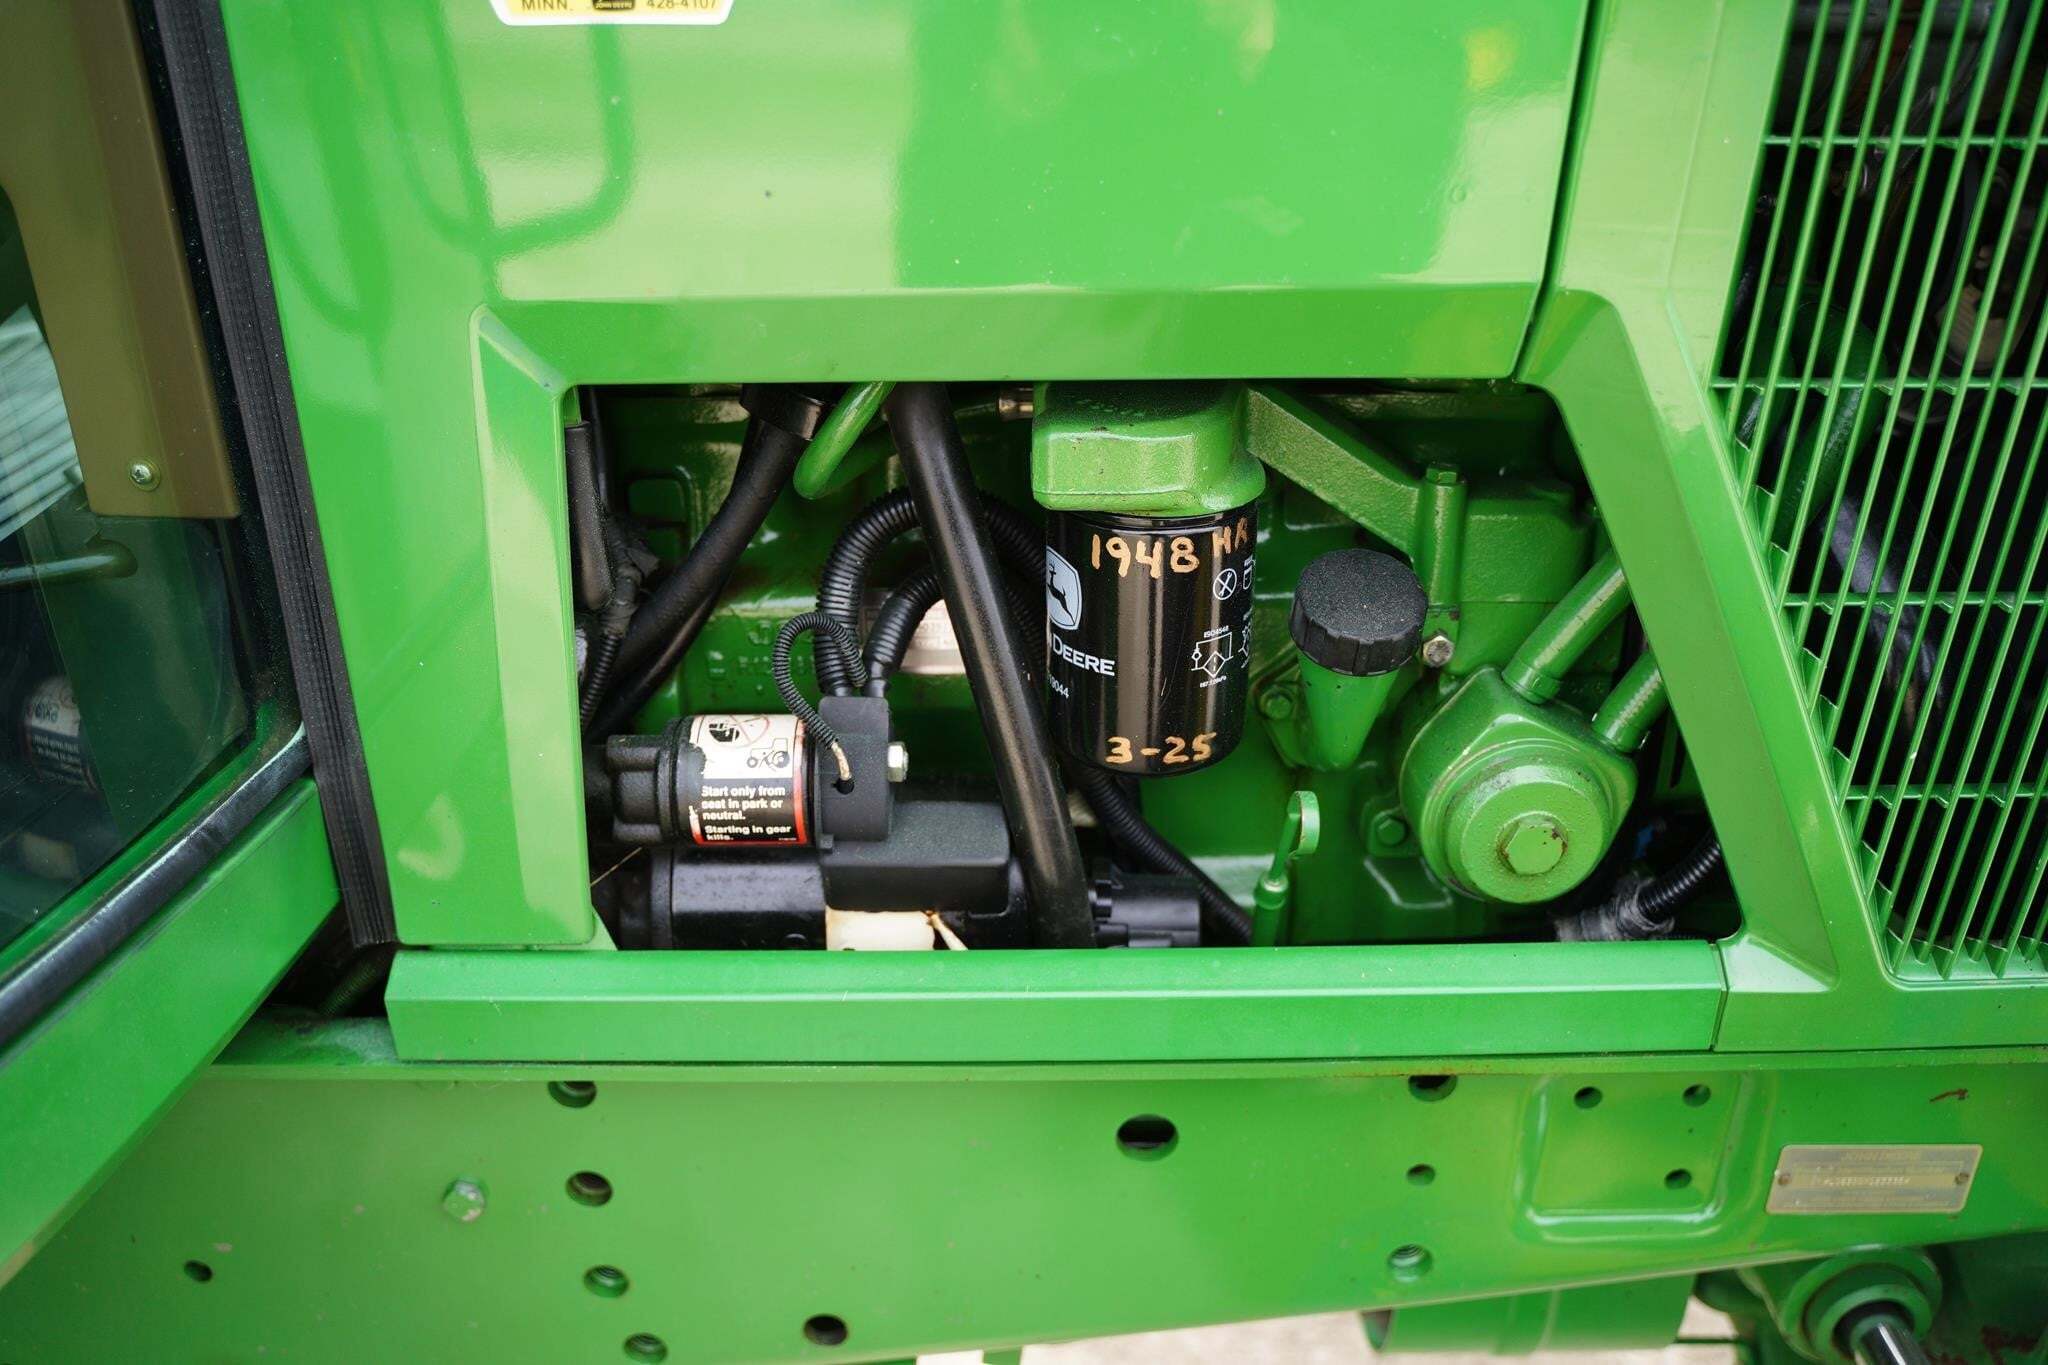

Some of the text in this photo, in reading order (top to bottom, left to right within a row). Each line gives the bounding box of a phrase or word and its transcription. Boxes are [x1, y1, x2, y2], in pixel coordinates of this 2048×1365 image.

[1091, 533, 1200, 579] 1948
[1052, 632, 1115, 677] DEERE
[1104, 731, 1217, 765] 3-25
[701, 786, 786, 799] Start only from
[701, 799, 784, 811] seat in park or
[702, 811, 746, 820] neutral.
[704, 825, 792, 835] Starting in gear
